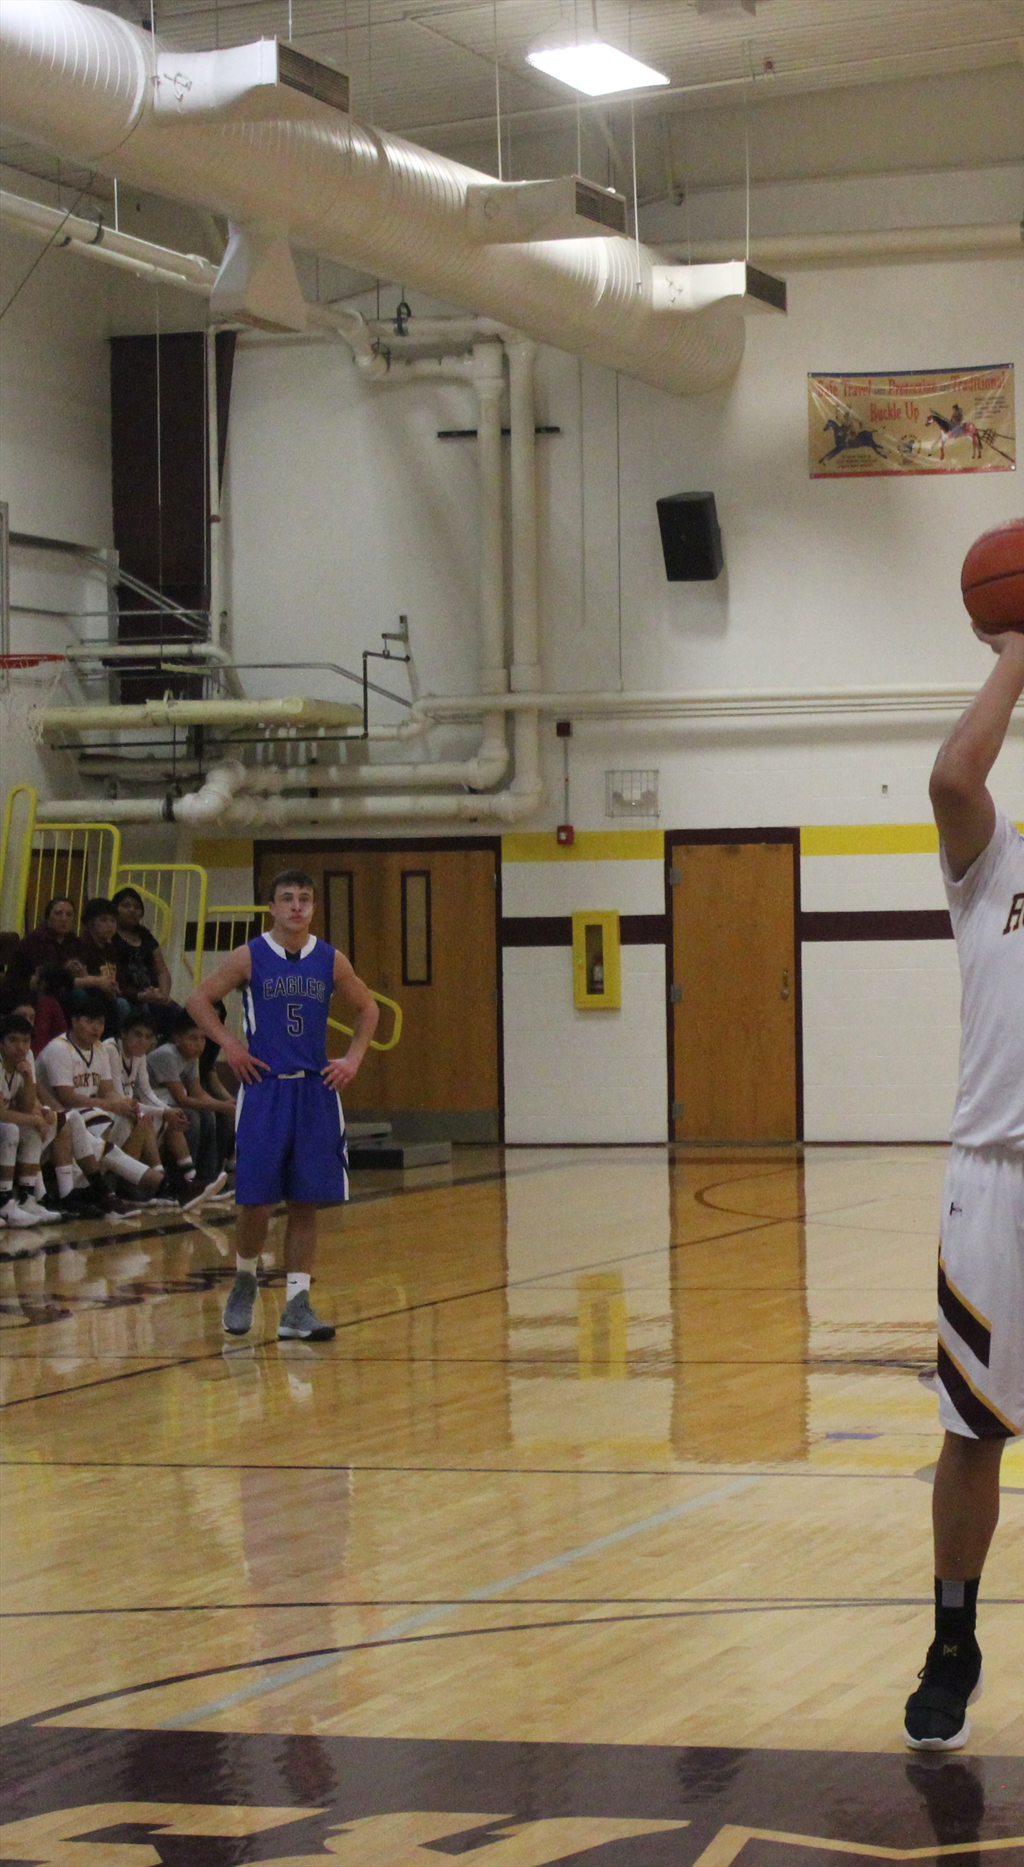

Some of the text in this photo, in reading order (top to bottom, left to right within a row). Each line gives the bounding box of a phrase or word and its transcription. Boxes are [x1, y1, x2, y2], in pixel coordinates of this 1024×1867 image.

[841, 379, 872, 396] Travel
[888, 378, 938, 396] Protection
[869, 401, 920, 423] Buckle Up
[263, 976, 326, 1003] EAGLES
[286, 1004, 304, 1037] 5
